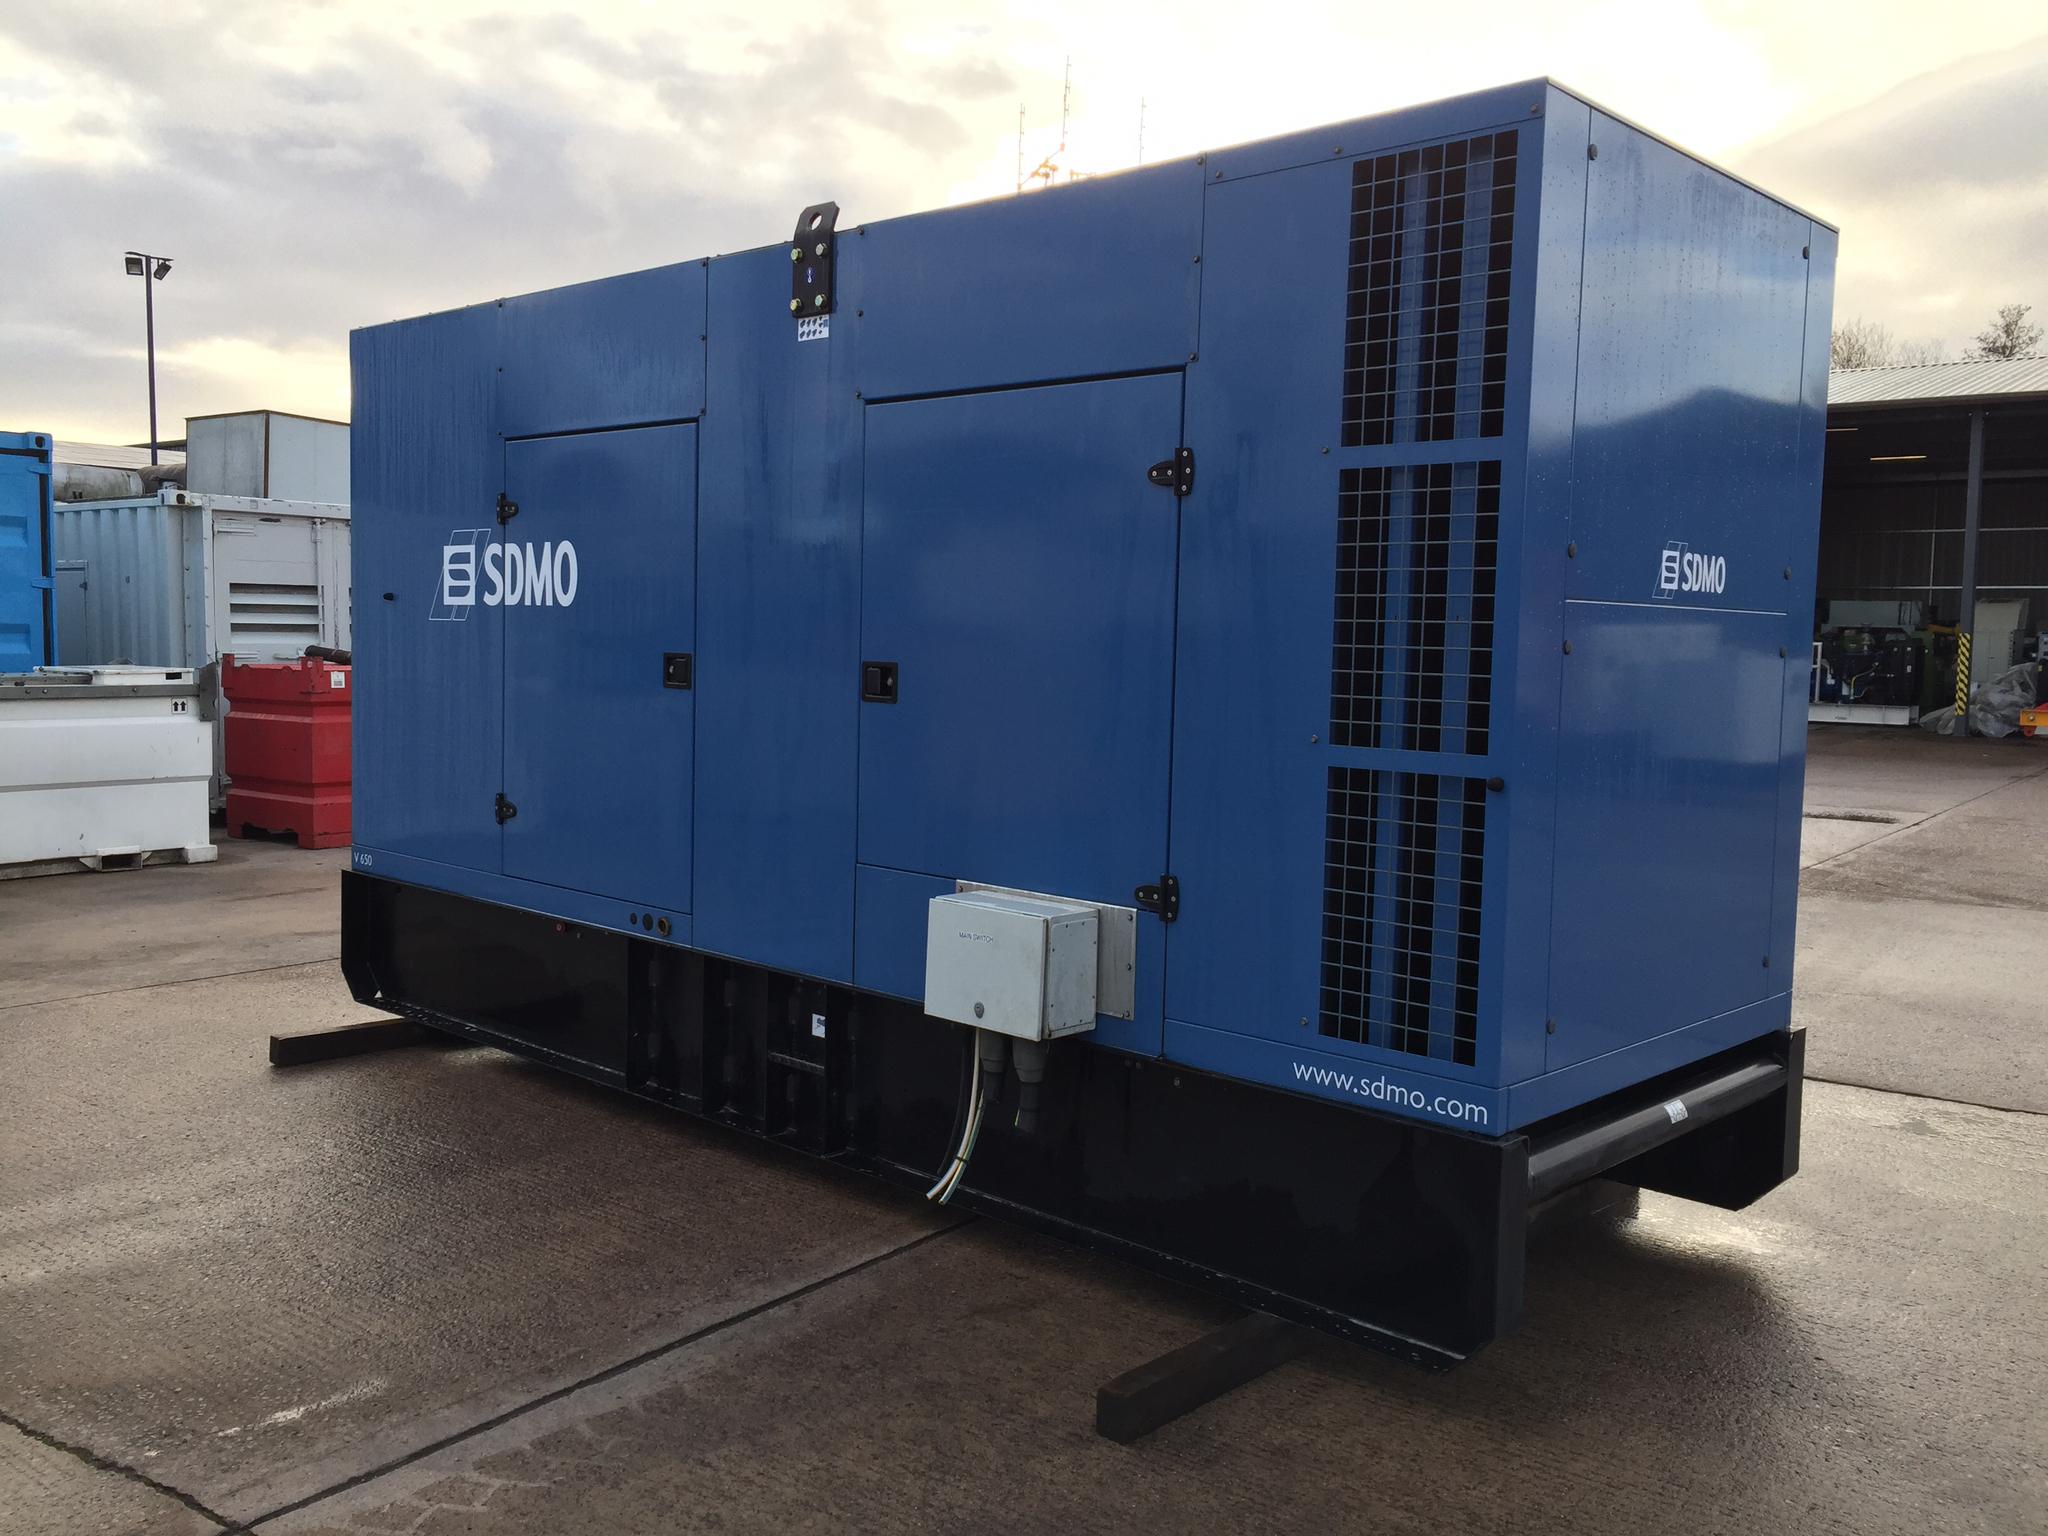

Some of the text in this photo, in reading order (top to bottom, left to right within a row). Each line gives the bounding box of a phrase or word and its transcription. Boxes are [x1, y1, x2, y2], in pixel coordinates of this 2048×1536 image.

[482, 540, 578, 607] SDMO
[1681, 552, 1726, 594] SDMO
[353, 852, 373, 866] V 650
[1292, 1062, 1488, 1125] www.sdmo.com
